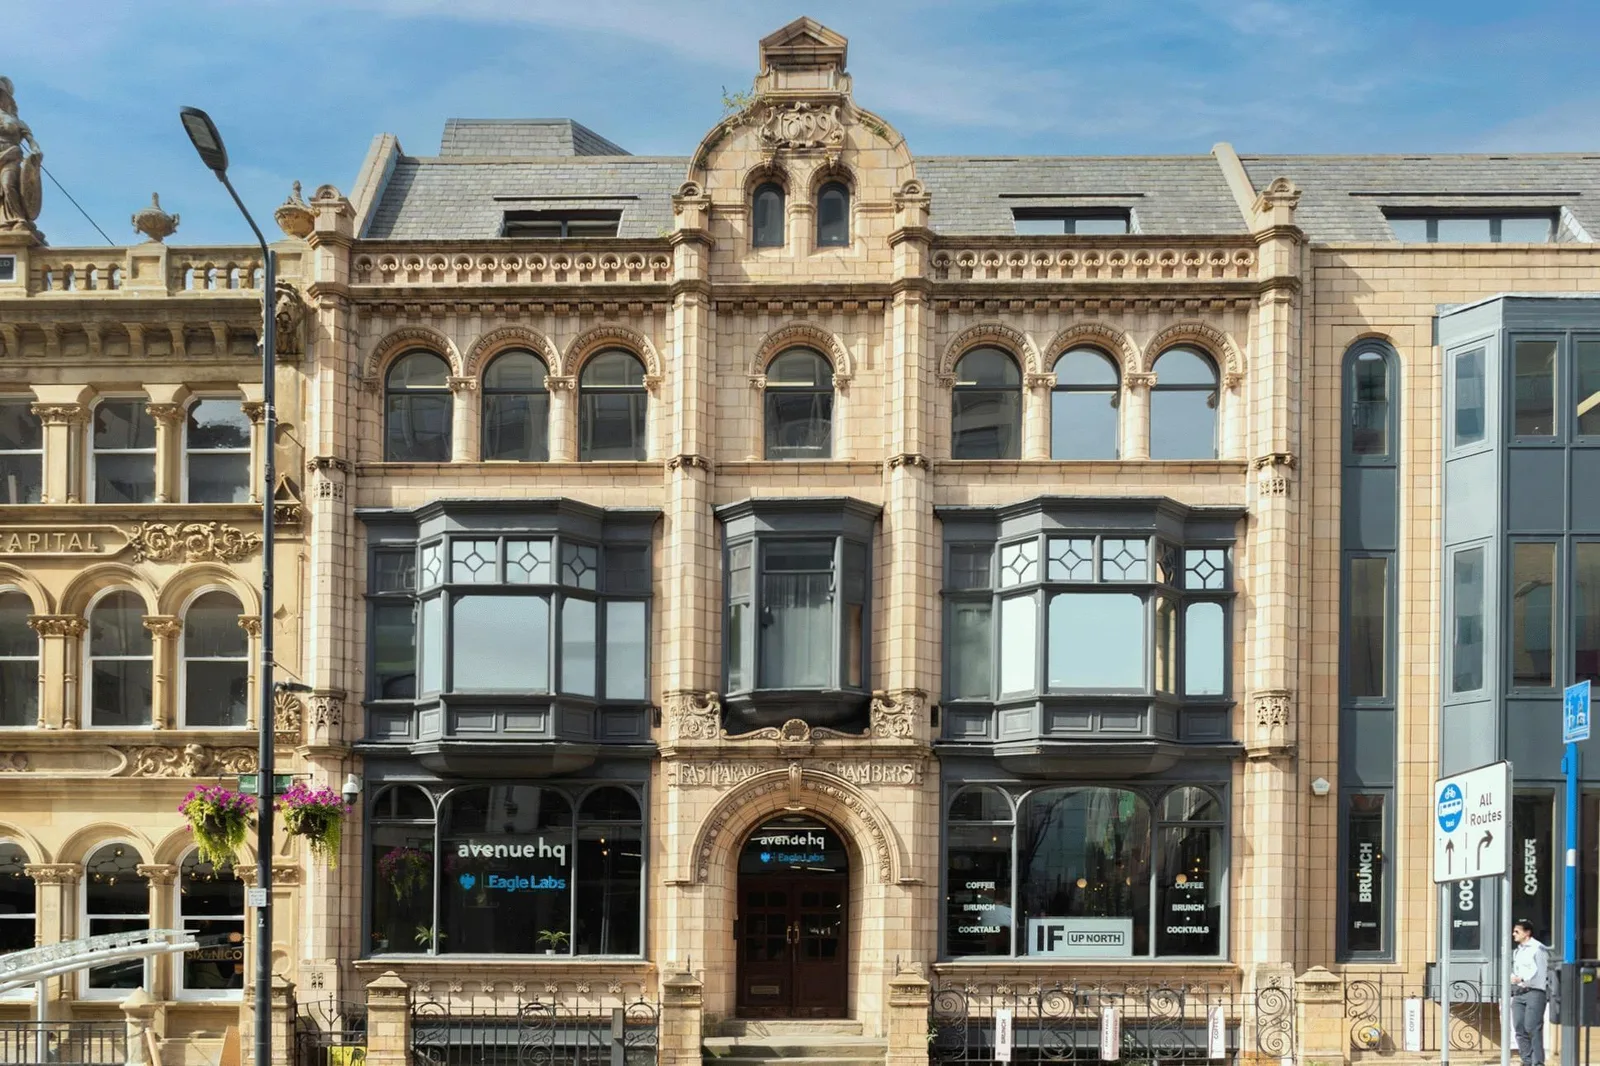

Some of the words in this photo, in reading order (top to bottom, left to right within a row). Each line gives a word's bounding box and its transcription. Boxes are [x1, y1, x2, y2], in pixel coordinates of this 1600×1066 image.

[0, 533, 98, 550] APITAL
[680, 763, 711, 785] EAST
[826, 761, 914, 785] CHAMBERS
[1479, 792, 1492, 807] All
[1470, 810, 1502, 826] Routes
[458, 844, 535, 858] avenue
[538, 836, 566, 866] hq
[1359, 843, 1373, 903] BRUNCH
[488, 874, 529, 892] Eagle
[530, 874, 566, 889] Labs
[965, 881, 996, 890] COFFEE
[1174, 881, 1204, 889] COFFEE
[963, 903, 996, 911] BRUNCH
[1172, 903, 1205, 911] BRUNCH
[958, 925, 1001, 934] COCKTAILS
[1166, 925, 1210, 934] COCKTAILS
[1036, 925, 1065, 951] IF
[1070, 934, 1085, 943] UP
[1086, 934, 1121, 943] NORTH
